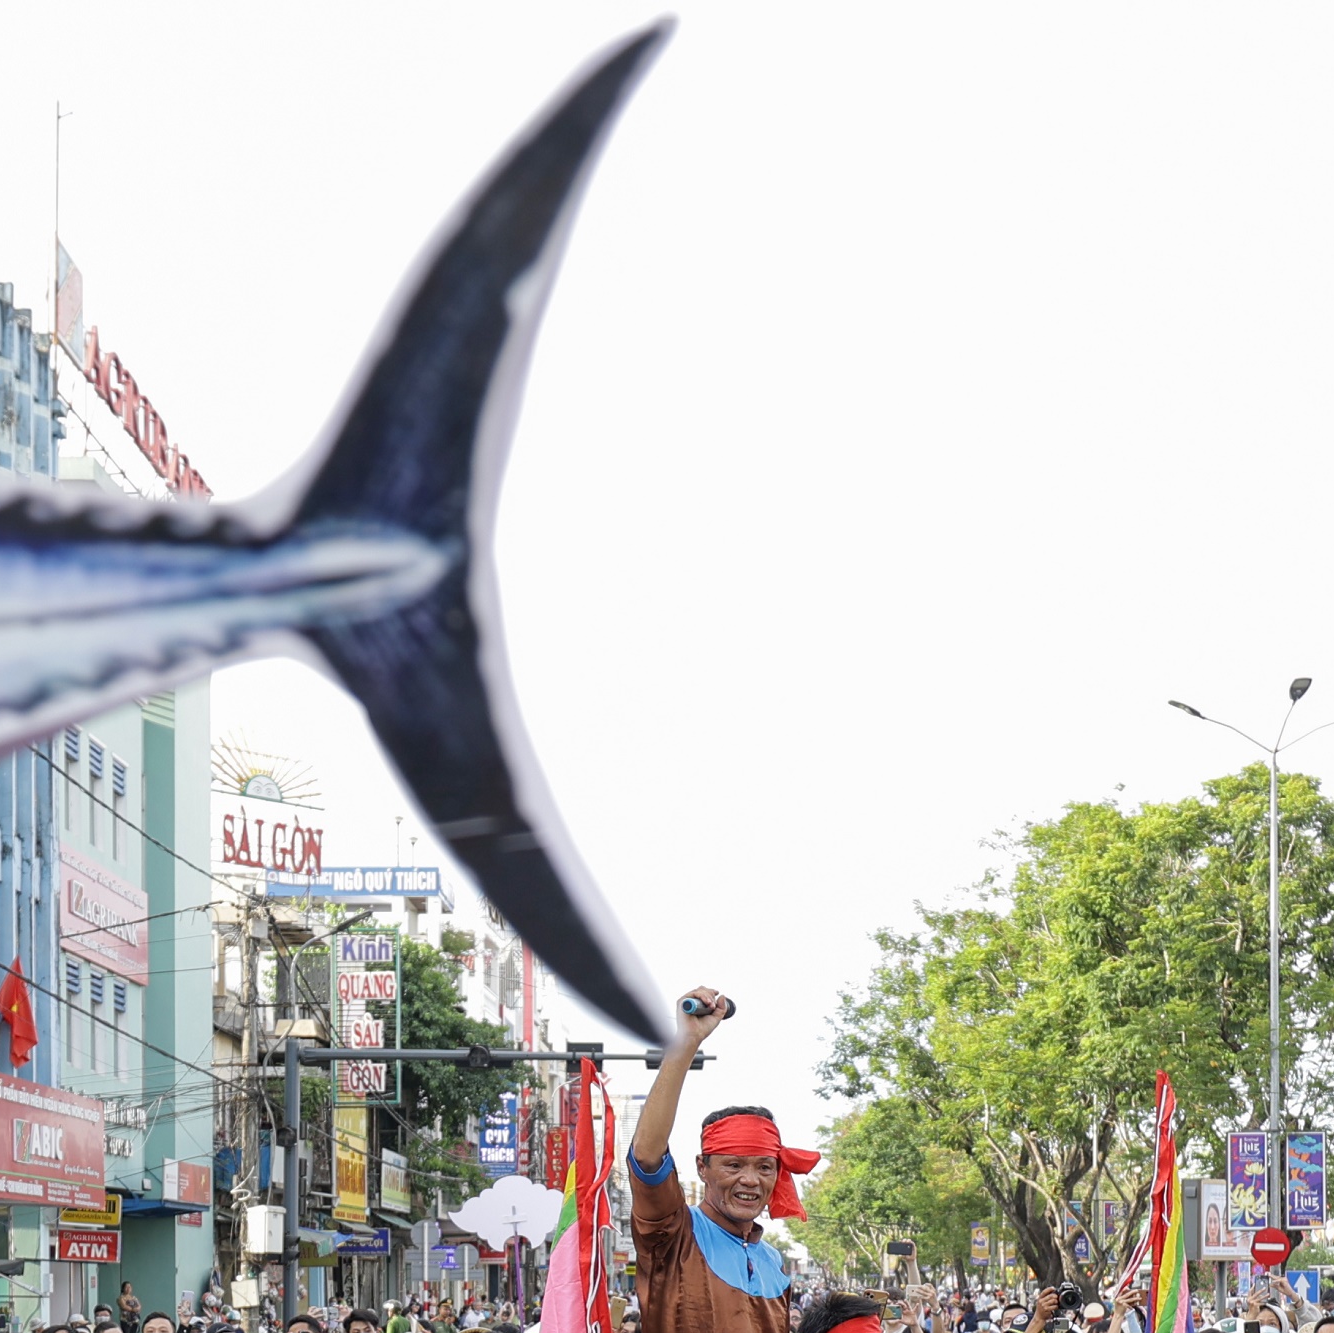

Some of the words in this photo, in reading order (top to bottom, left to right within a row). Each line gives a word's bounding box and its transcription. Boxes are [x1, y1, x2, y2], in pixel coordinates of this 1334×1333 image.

[333, 868, 365, 891] NGÔ
[365, 868, 394, 891] QUÝ
[396, 868, 437, 891] THÍCH
[85, 897, 139, 948] AGRIBANK
[342, 936, 390, 961] Kính
[338, 973, 395, 1003] QUANG
[31, 1122, 64, 1160] ABIC
[480, 1145, 515, 1163] THÍCH
[72, 1234, 113, 1242] AGRIBANK
[67, 1243, 108, 1259] ATM
